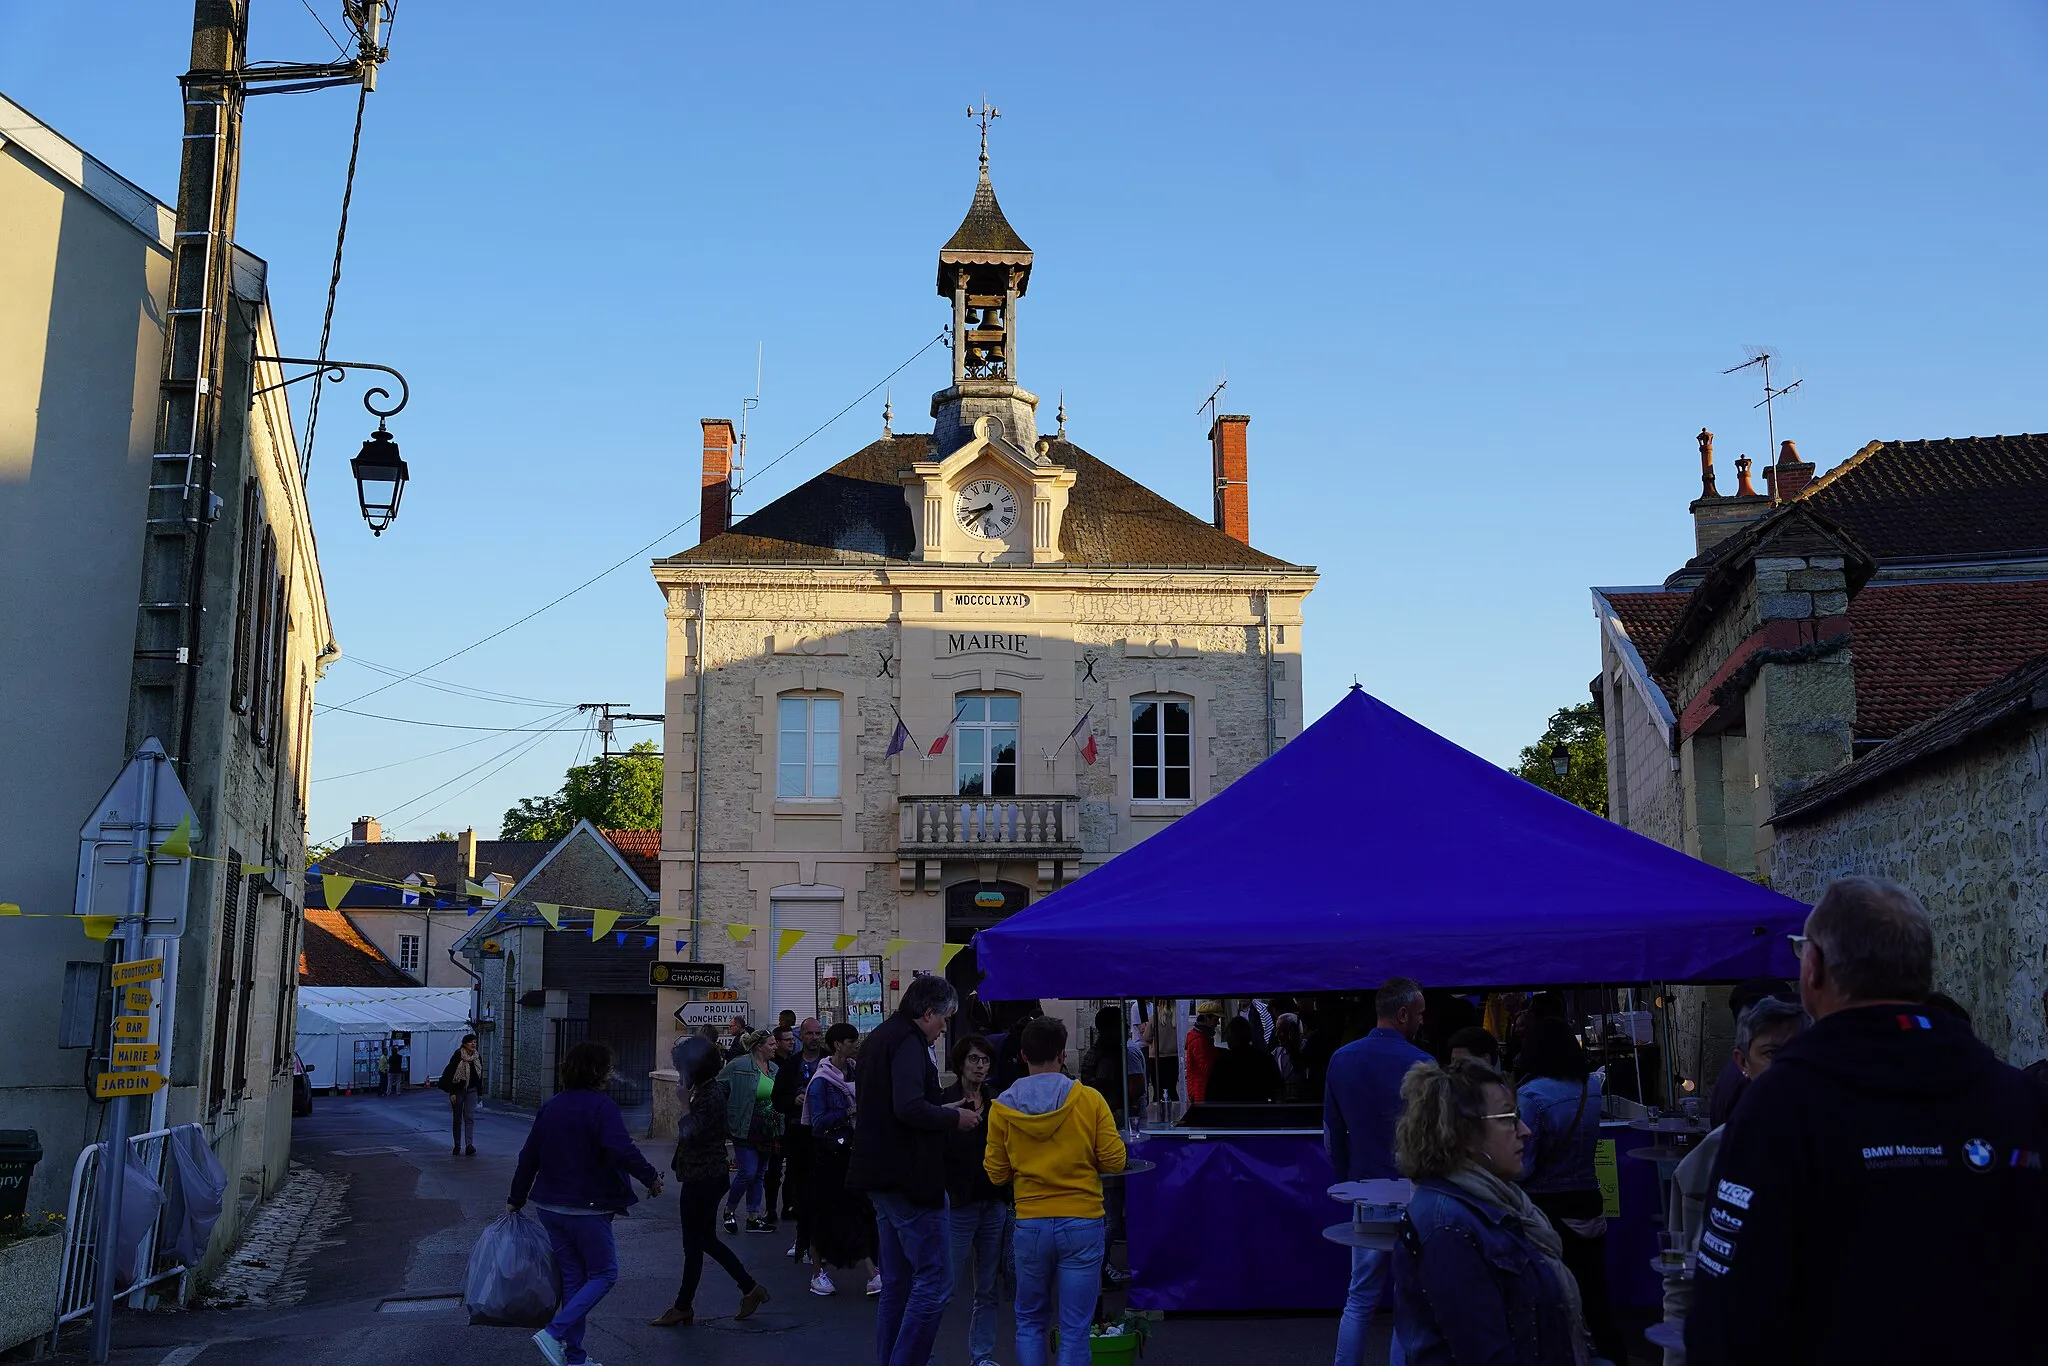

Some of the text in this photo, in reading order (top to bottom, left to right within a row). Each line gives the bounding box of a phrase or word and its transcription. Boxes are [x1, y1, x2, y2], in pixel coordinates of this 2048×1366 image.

[955, 595, 1022, 606] MDCCCLXXXI
[948, 633, 1028, 655] MAIRIE
[121, 965, 154, 980] FOODTRUCKS
[671, 974, 721, 983] CHAMPAGNE
[131, 992, 148, 1006] FORGE
[722, 991, 733, 999] 75
[704, 1005, 745, 1014] PROUILLY
[687, 1015, 728, 1024] JONCHERY
[126, 1021, 143, 1033] BAR
[117, 1047, 149, 1062] MAIRIE
[101, 1075, 149, 1091] JARDIN
[1861, 1144, 1943, 1159] BMW Motorrad
